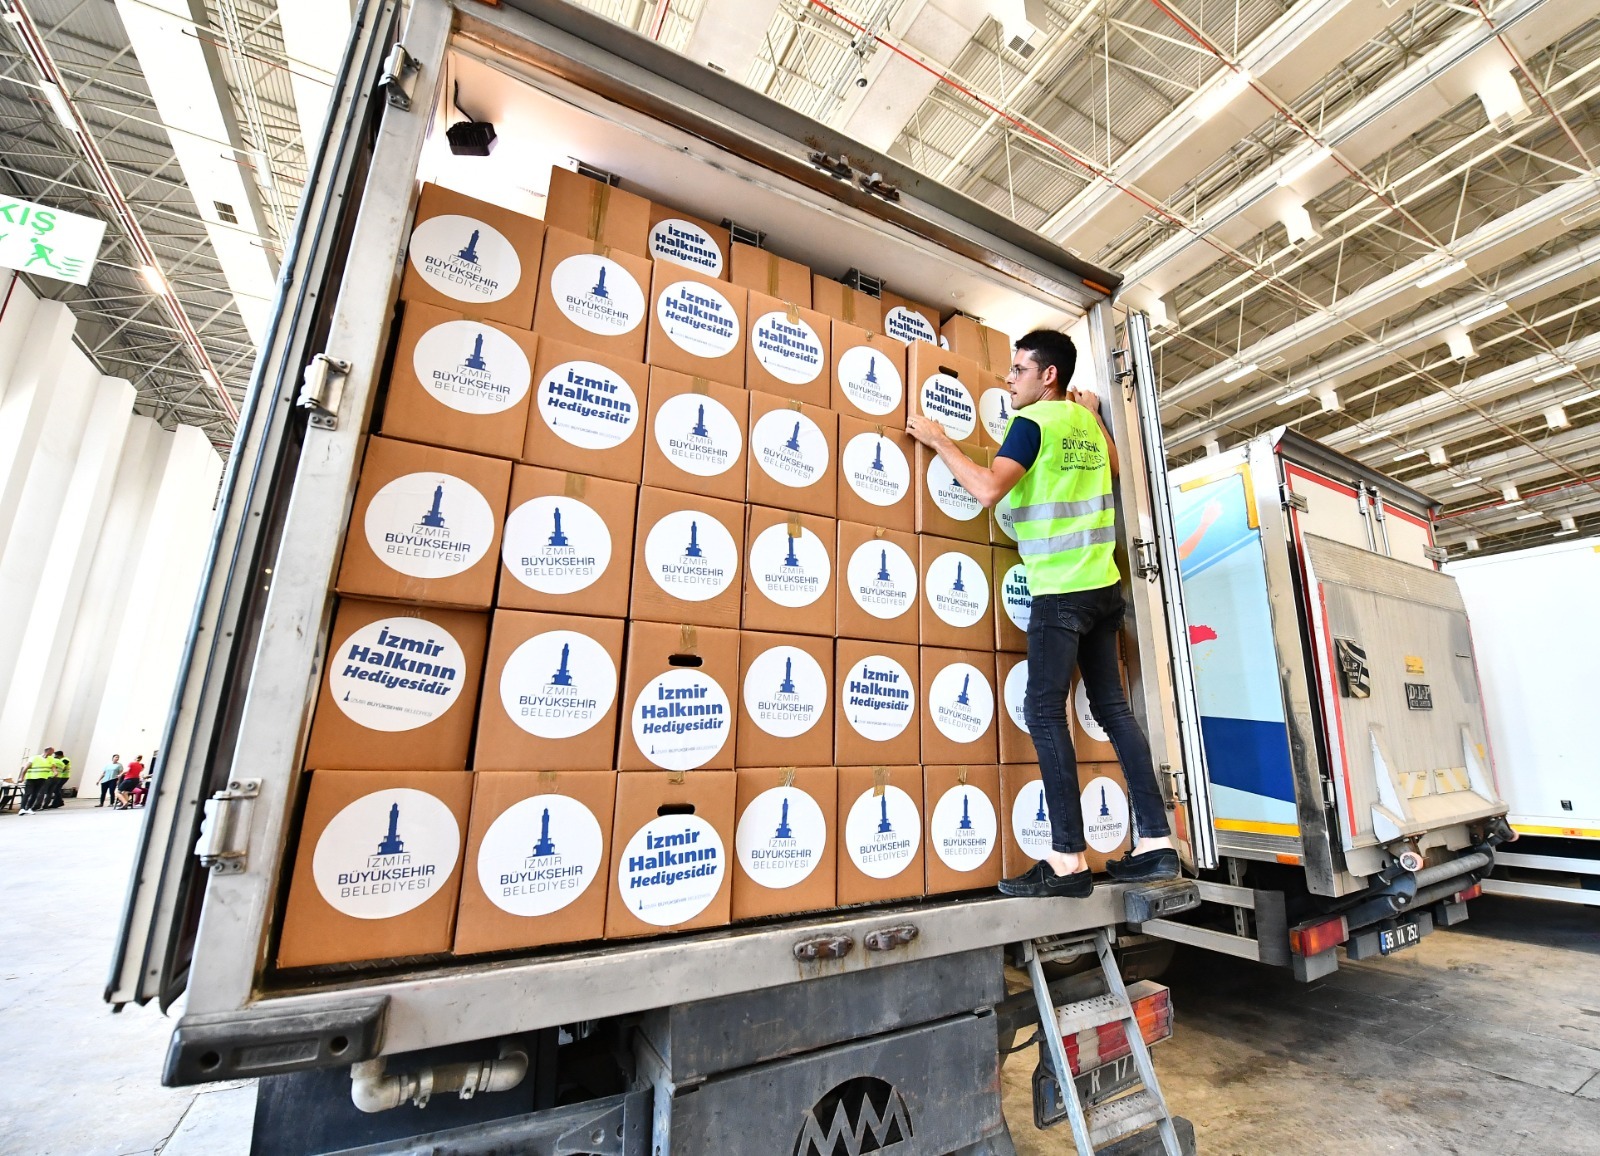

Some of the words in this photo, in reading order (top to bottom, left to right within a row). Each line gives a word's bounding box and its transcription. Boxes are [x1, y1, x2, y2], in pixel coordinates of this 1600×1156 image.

[669, 224, 705, 245] İzmir
[655, 233, 716, 259] Halkının
[656, 244, 716, 269] Hediyesidir
[426, 266, 493, 296] BELEDİYESİ
[681, 287, 722, 311] İzmir
[568, 304, 626, 327] BELEDİYESİ
[666, 297, 733, 328] Halkının
[898, 311, 924, 328] İzmir
[665, 310, 732, 338] Hediyesidir
[772, 318, 807, 339] İzmir
[889, 318, 932, 340] Halkının
[759, 328, 818, 355] Halkının
[759, 341, 818, 364] Hediyesidir
[434, 380, 506, 403] BELEDİYESİ
[568, 368, 618, 394] İzmir
[935, 379, 963, 398] İzmir
[548, 382, 631, 412] Halkının
[926, 390, 971, 412] Halkının
[547, 397, 630, 424] Hediyesidir
[926, 401, 971, 422] Hediyesidir
[671, 448, 726, 465] BELEDİYESİ
[764, 456, 810, 479] BELEDİYESİ
[387, 544, 466, 562] BELEDİYESİ
[526, 567, 592, 576] BELEDİYESİ
[664, 574, 721, 585] BELEDİYESİ
[1006, 584, 1031, 596] Halk
[377, 626, 444, 657] İzmir
[348, 645, 456, 680] Halkının
[342, 664, 451, 696] Hediyesidir
[863, 665, 899, 683] İzmir
[658, 683, 707, 700] İzmir
[850, 681, 909, 699] Halkının
[521, 707, 592, 719] BELEDİYESİ
[641, 702, 723, 719] Halkının
[850, 696, 909, 710] Hediyesidir
[643, 718, 724, 734] Hediyesidir
[760, 712, 811, 721] BELEDİYESİ
[647, 828, 700, 850] İzmir
[629, 848, 716, 872] Halkının
[753, 860, 809, 870] BELEDİYESİ
[863, 850, 908, 863] BELEDİYESİ
[630, 864, 717, 888] Hediyesidir
[341, 878, 430, 898] BELEDİYESİ
[503, 878, 579, 897] BELEDİYESİ
[1385, 932, 1394, 949] 35
[1407, 924, 1418, 941] 252
